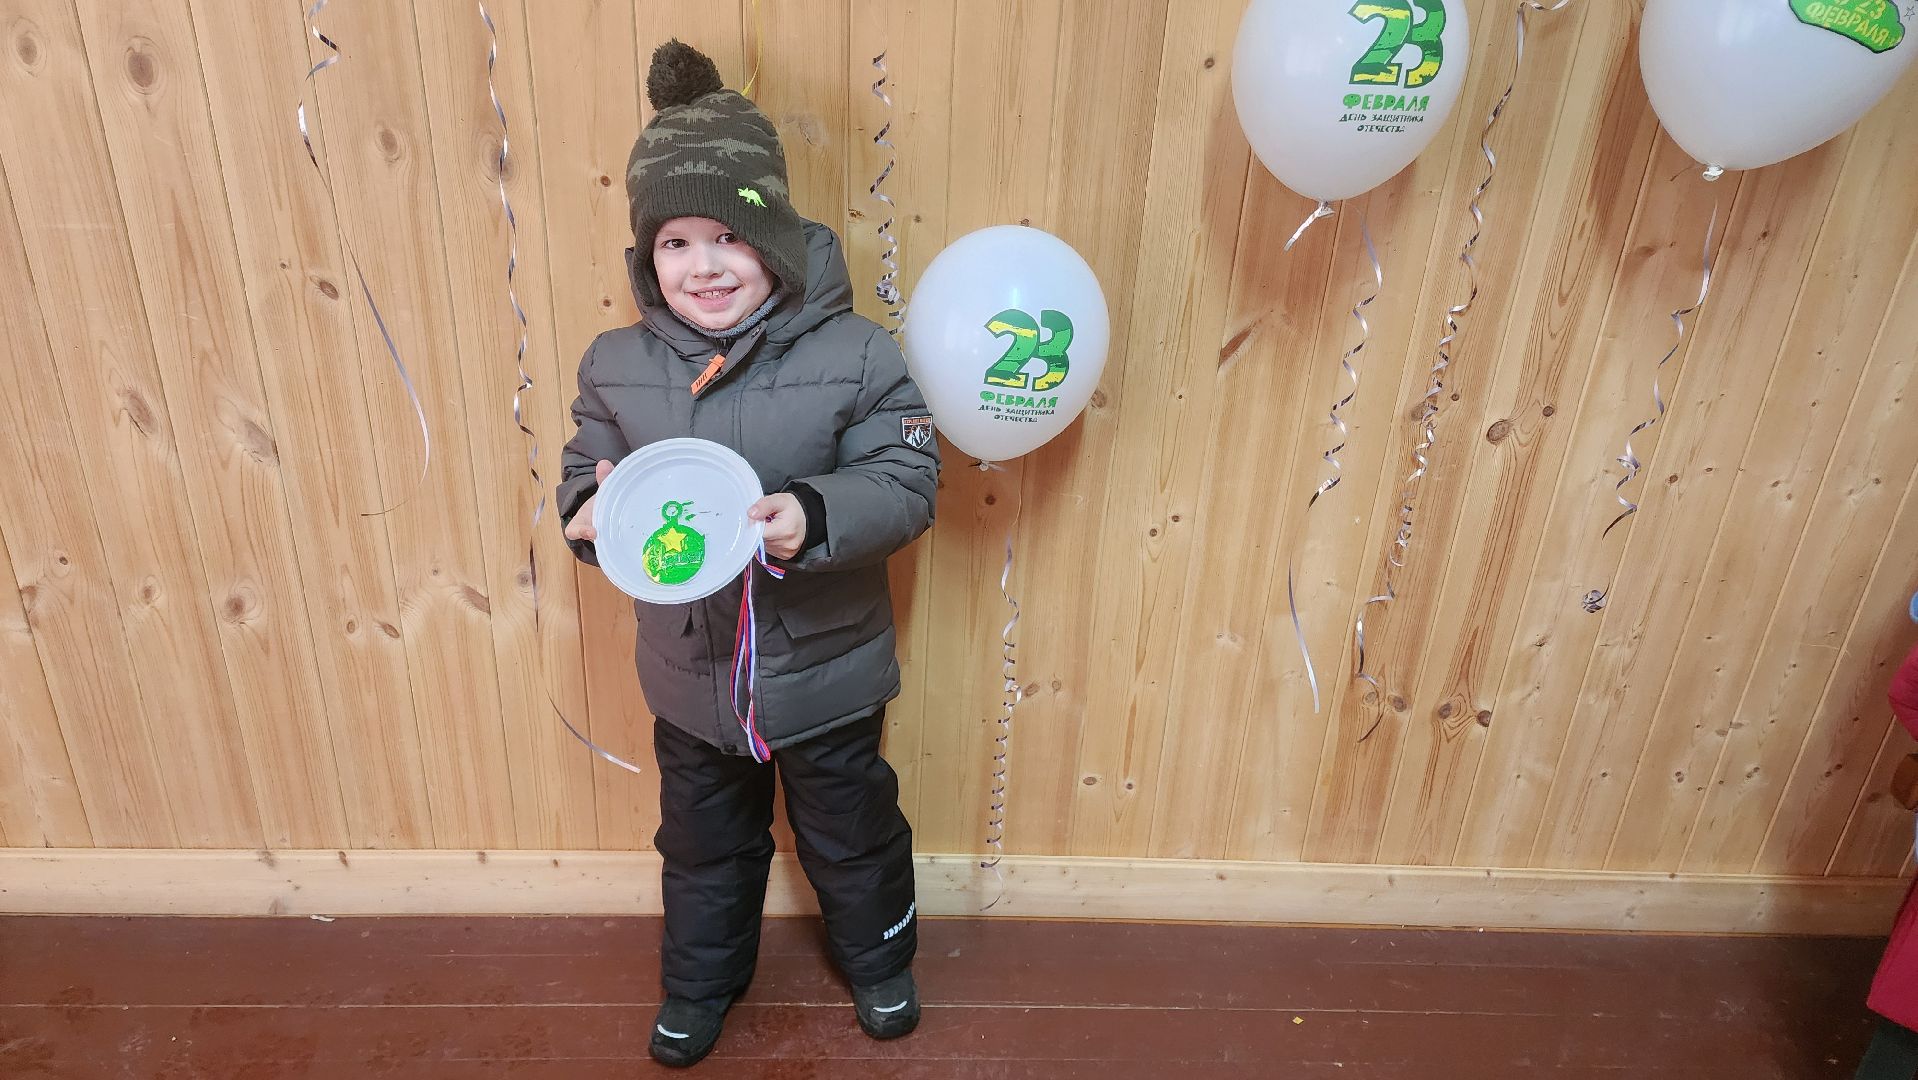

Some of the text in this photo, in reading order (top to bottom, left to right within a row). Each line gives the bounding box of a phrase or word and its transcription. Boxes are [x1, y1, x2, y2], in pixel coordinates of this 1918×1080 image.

[1806, 2, 1889, 46] ФЕВРАЛЯ
[1348, 0, 1446, 88] 23
[1342, 94, 1430, 111] ФЕВРАЛЯ
[1339, 114, 1424, 122] ДЕНЬ ЗАЩИТНИКА
[984, 308, 1074, 392] 23
[980, 391, 1058, 408] ФЕВРАЛЯ
[1005, 407, 1055, 415] ЗАЩИТНИКА
